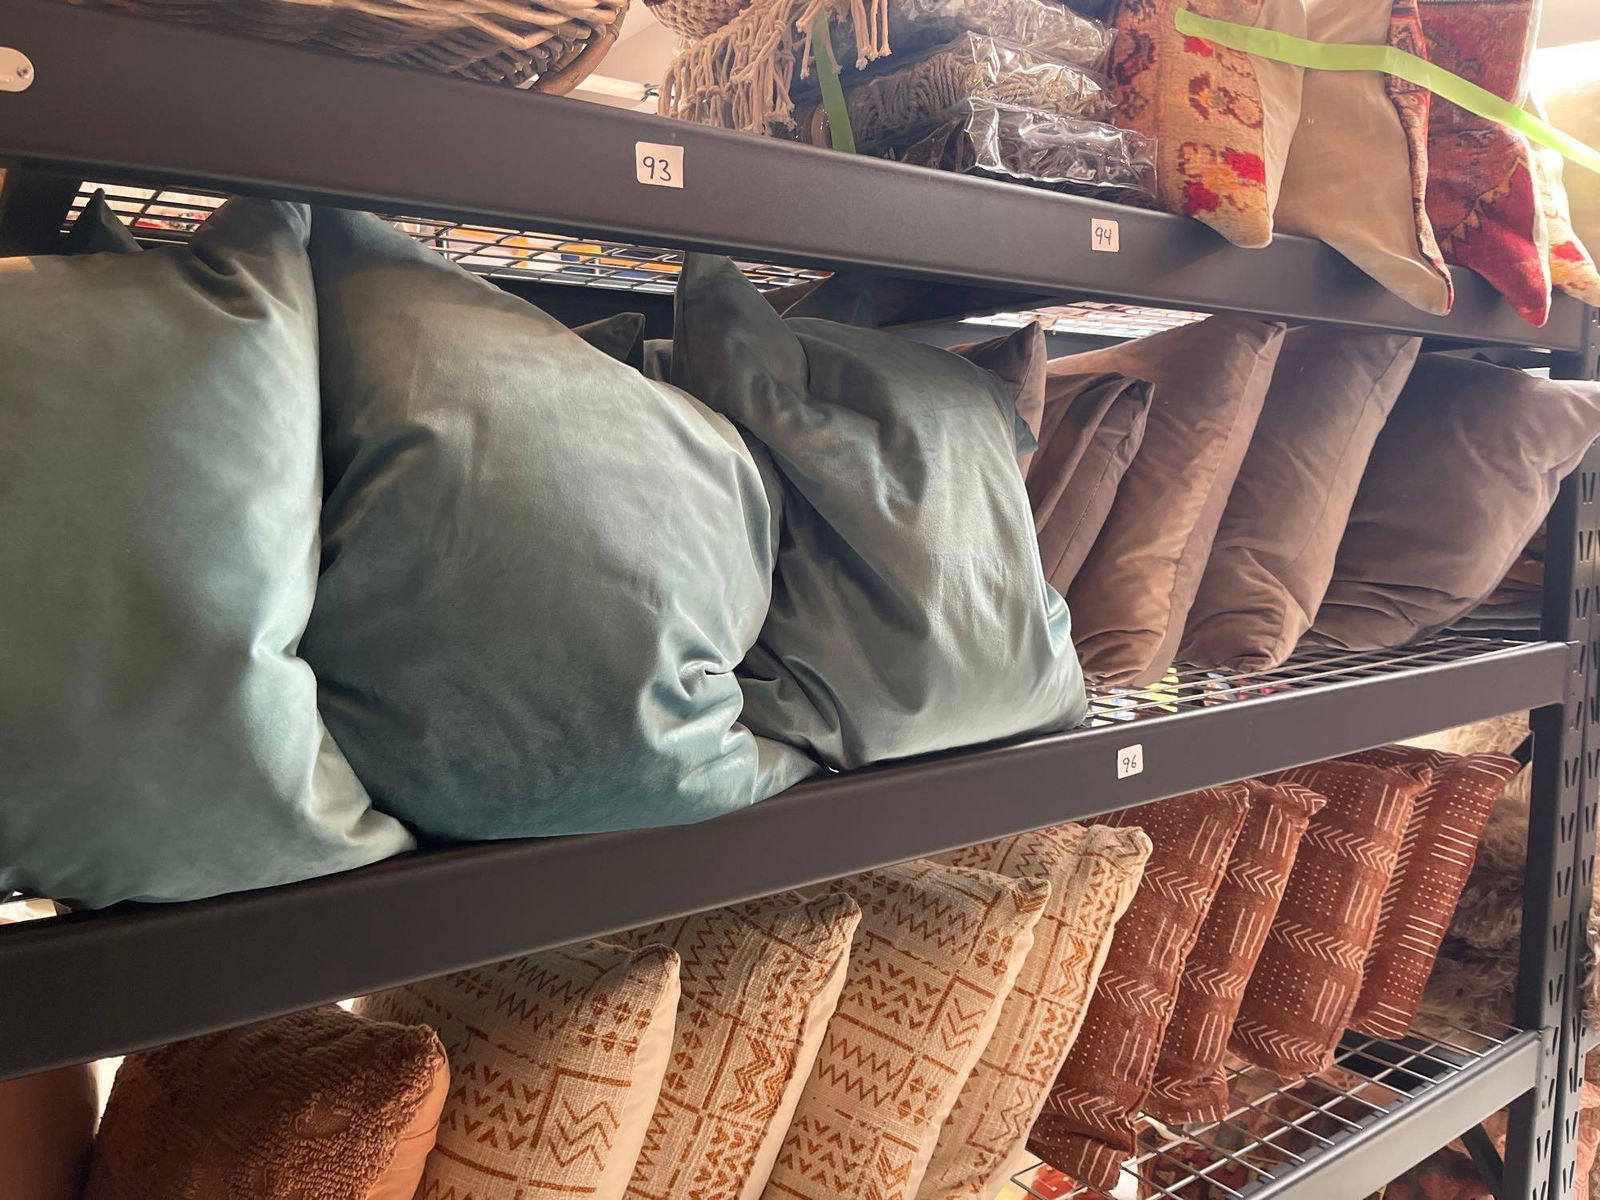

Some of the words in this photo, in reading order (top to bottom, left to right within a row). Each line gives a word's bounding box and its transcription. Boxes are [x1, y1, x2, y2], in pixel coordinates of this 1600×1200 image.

[643, 156, 671, 181] 93
[1095, 226, 1111, 245] 94
[1123, 755, 1136, 773] 96
